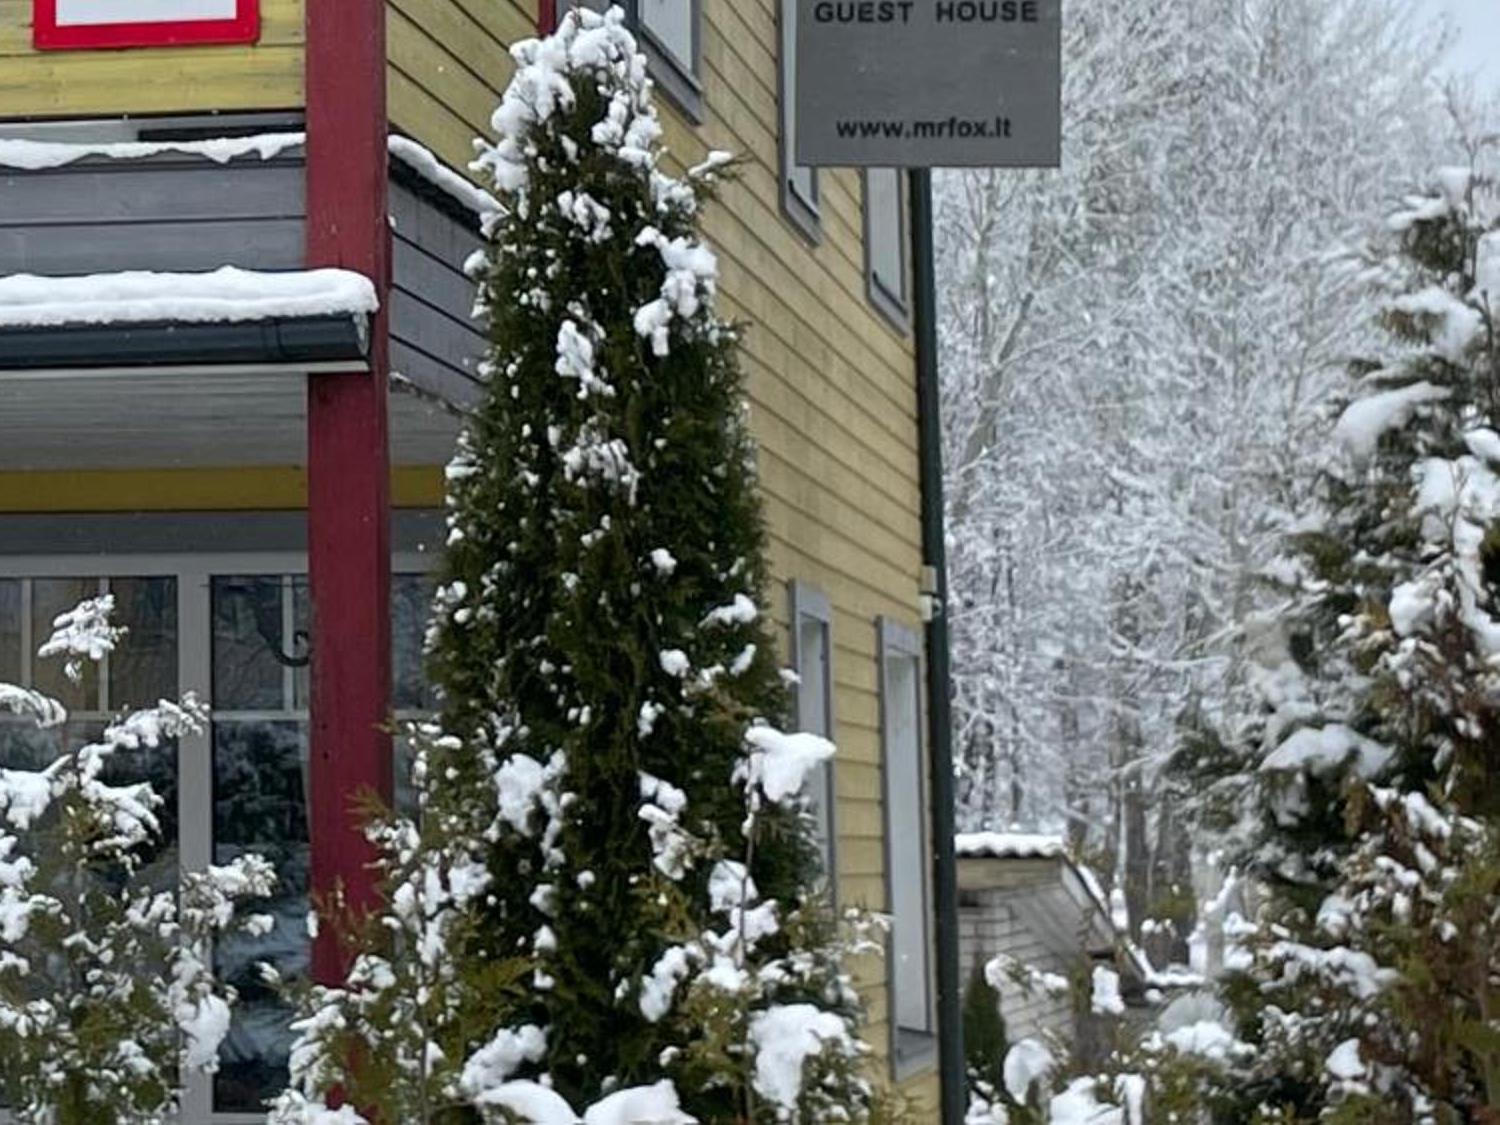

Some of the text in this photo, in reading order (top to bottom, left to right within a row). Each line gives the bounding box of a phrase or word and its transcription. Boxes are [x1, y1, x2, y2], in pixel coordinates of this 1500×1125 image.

[814, 0, 1038, 23] GUEST HOUSE
[836, 117, 1012, 139] www.mrfox.lt
